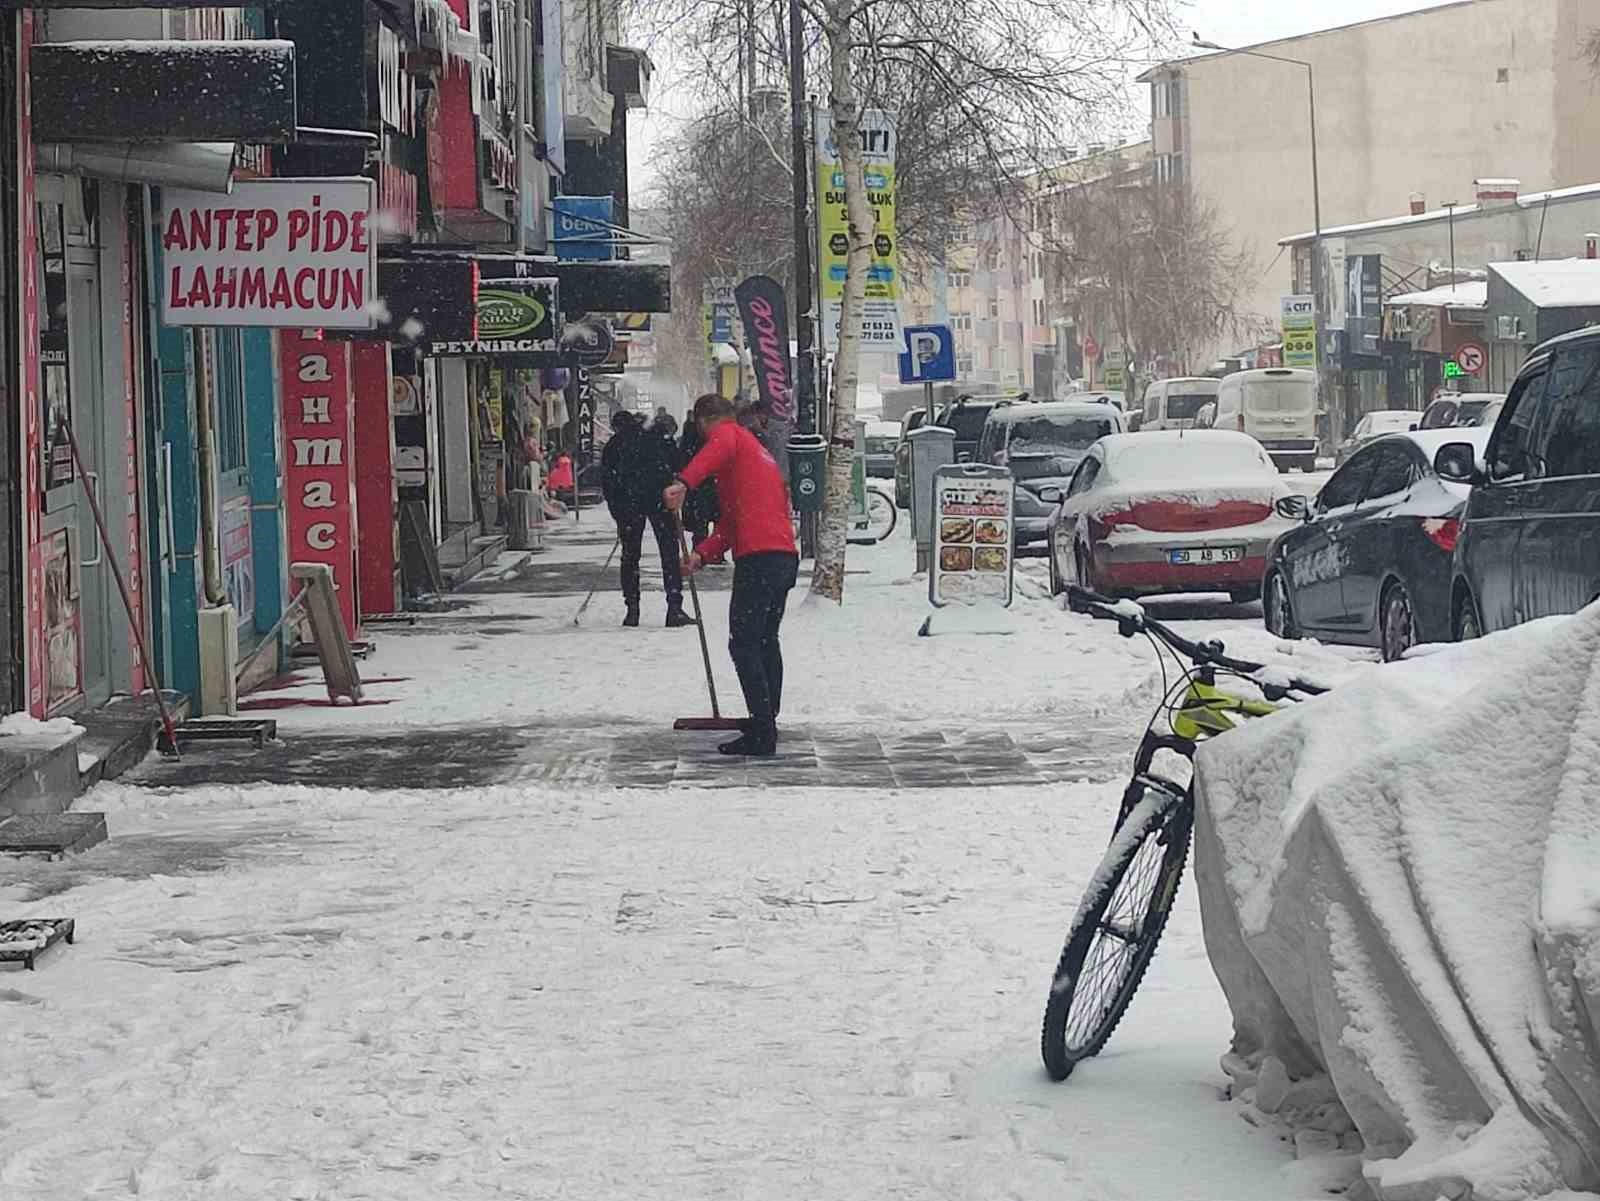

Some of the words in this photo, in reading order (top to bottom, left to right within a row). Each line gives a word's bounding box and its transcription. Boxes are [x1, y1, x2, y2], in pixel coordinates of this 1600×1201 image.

[164, 207, 279, 253] ANTEP
[287, 195, 369, 254] PİDE
[169, 265, 365, 311] LAHMACUN
[908, 331, 943, 378] P
[578, 367, 591, 453] CZANE
